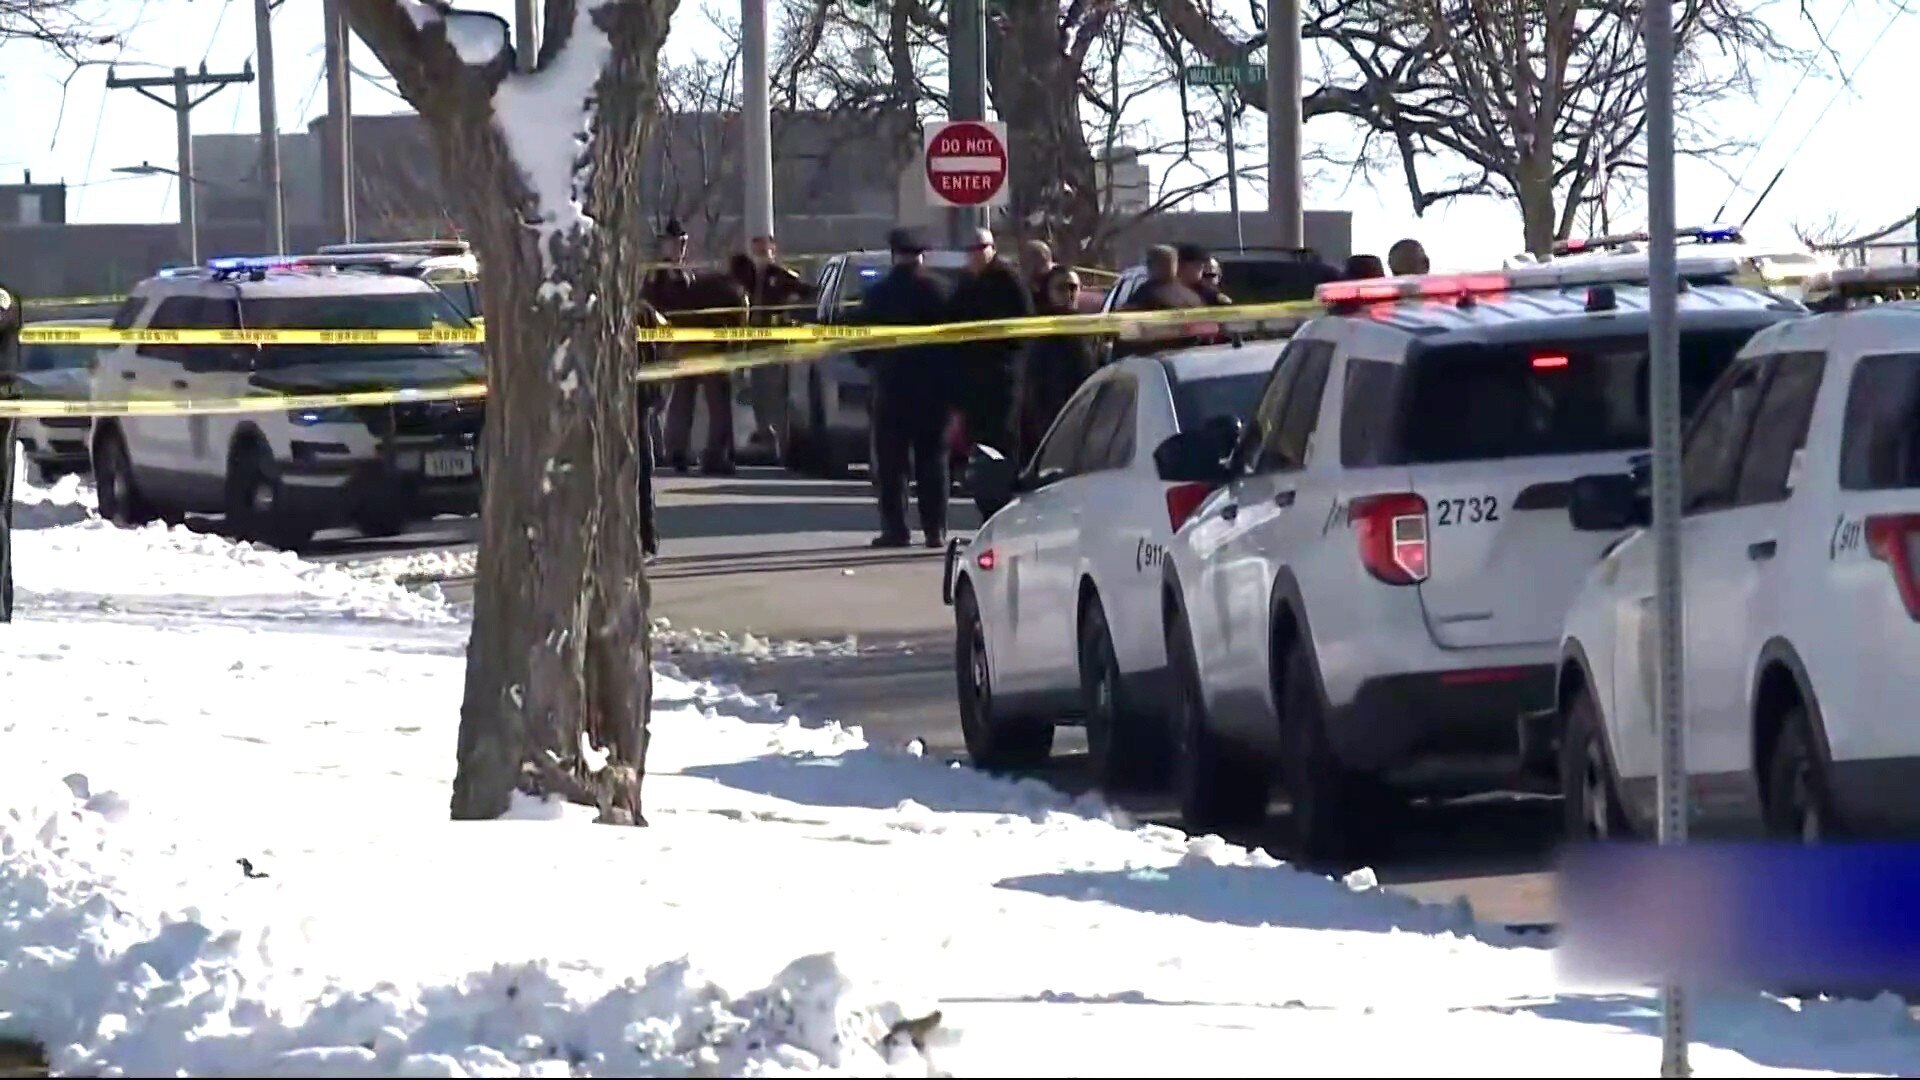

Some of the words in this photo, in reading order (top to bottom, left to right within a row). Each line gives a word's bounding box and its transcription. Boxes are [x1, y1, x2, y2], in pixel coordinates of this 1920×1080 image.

[1248, 66, 1263, 82] ST
[941, 138, 960, 154] DO
[966, 138, 994, 154] NOT
[942, 175, 991, 190] ENTER
[1437, 495, 1498, 526] 2732
[1145, 543, 1162, 567] 911
